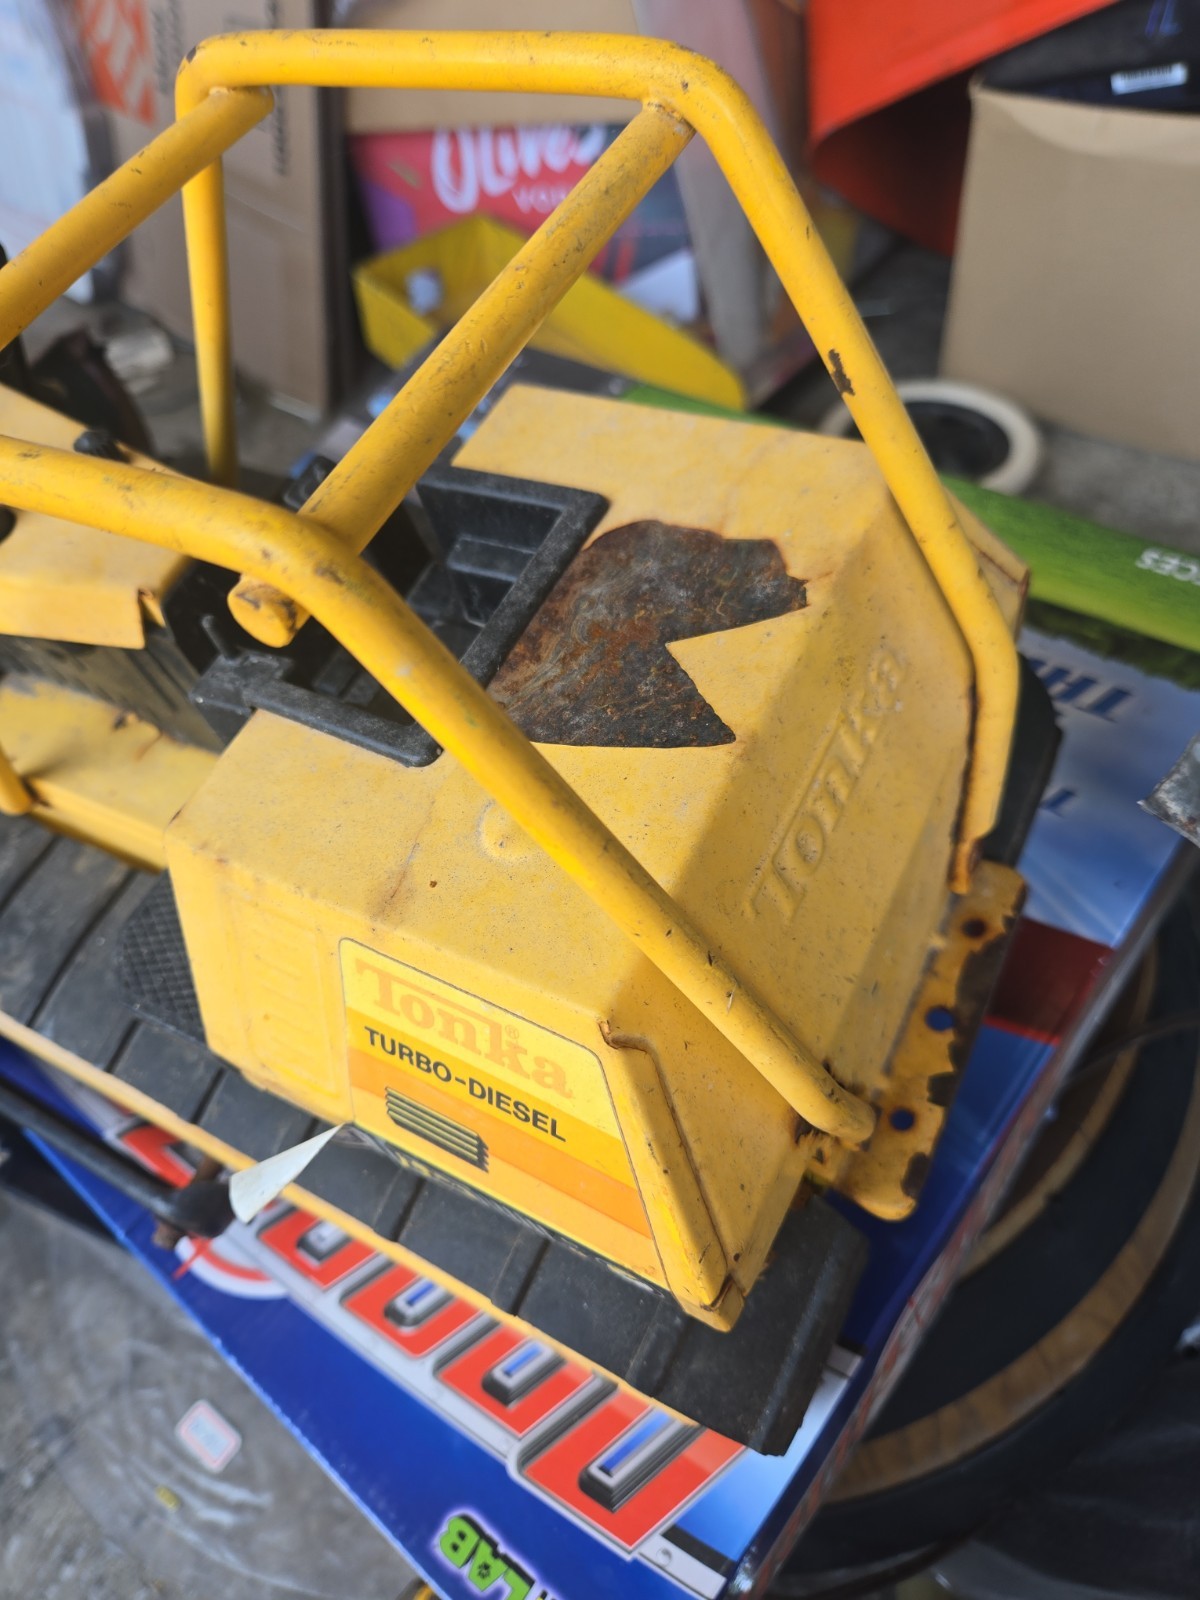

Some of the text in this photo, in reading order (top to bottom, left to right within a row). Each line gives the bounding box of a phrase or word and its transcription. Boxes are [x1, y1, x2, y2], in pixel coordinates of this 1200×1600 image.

[739, 647, 906, 925] Tonka
[355, 957, 574, 1099] Tonka
[363, 1025, 567, 1143] TURBO-DIESEL
